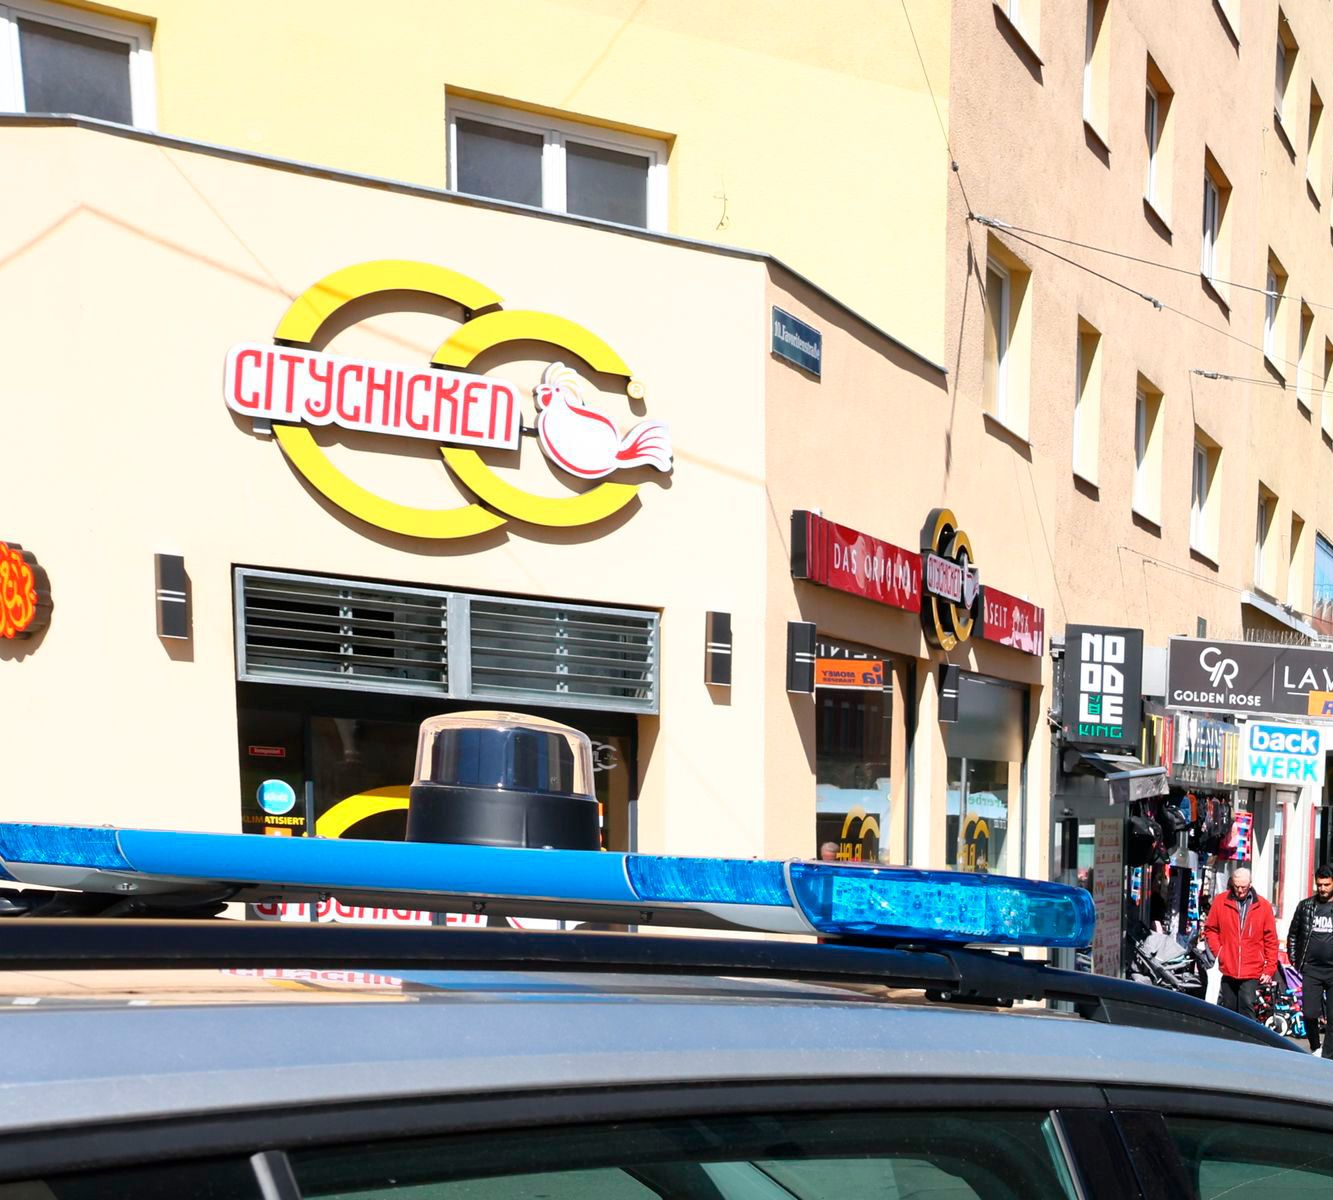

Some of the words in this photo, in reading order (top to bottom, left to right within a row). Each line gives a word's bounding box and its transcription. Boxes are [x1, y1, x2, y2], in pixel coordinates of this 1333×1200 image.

[233, 348, 518, 442] CITYCHICKEN
[833, 542, 857, 576] DAS
[864, 553, 918, 597] ORIGINAL
[988, 601, 1008, 629] SEIT
[1173, 689, 1225, 705] GOLDEN
[1228, 692, 1262, 707] ROSE
[1078, 724, 1123, 738] KING
[1252, 725, 1319, 755] back
[1248, 755, 1319, 783] WERK
[243, 815, 305, 826] KLIMATISIERT
